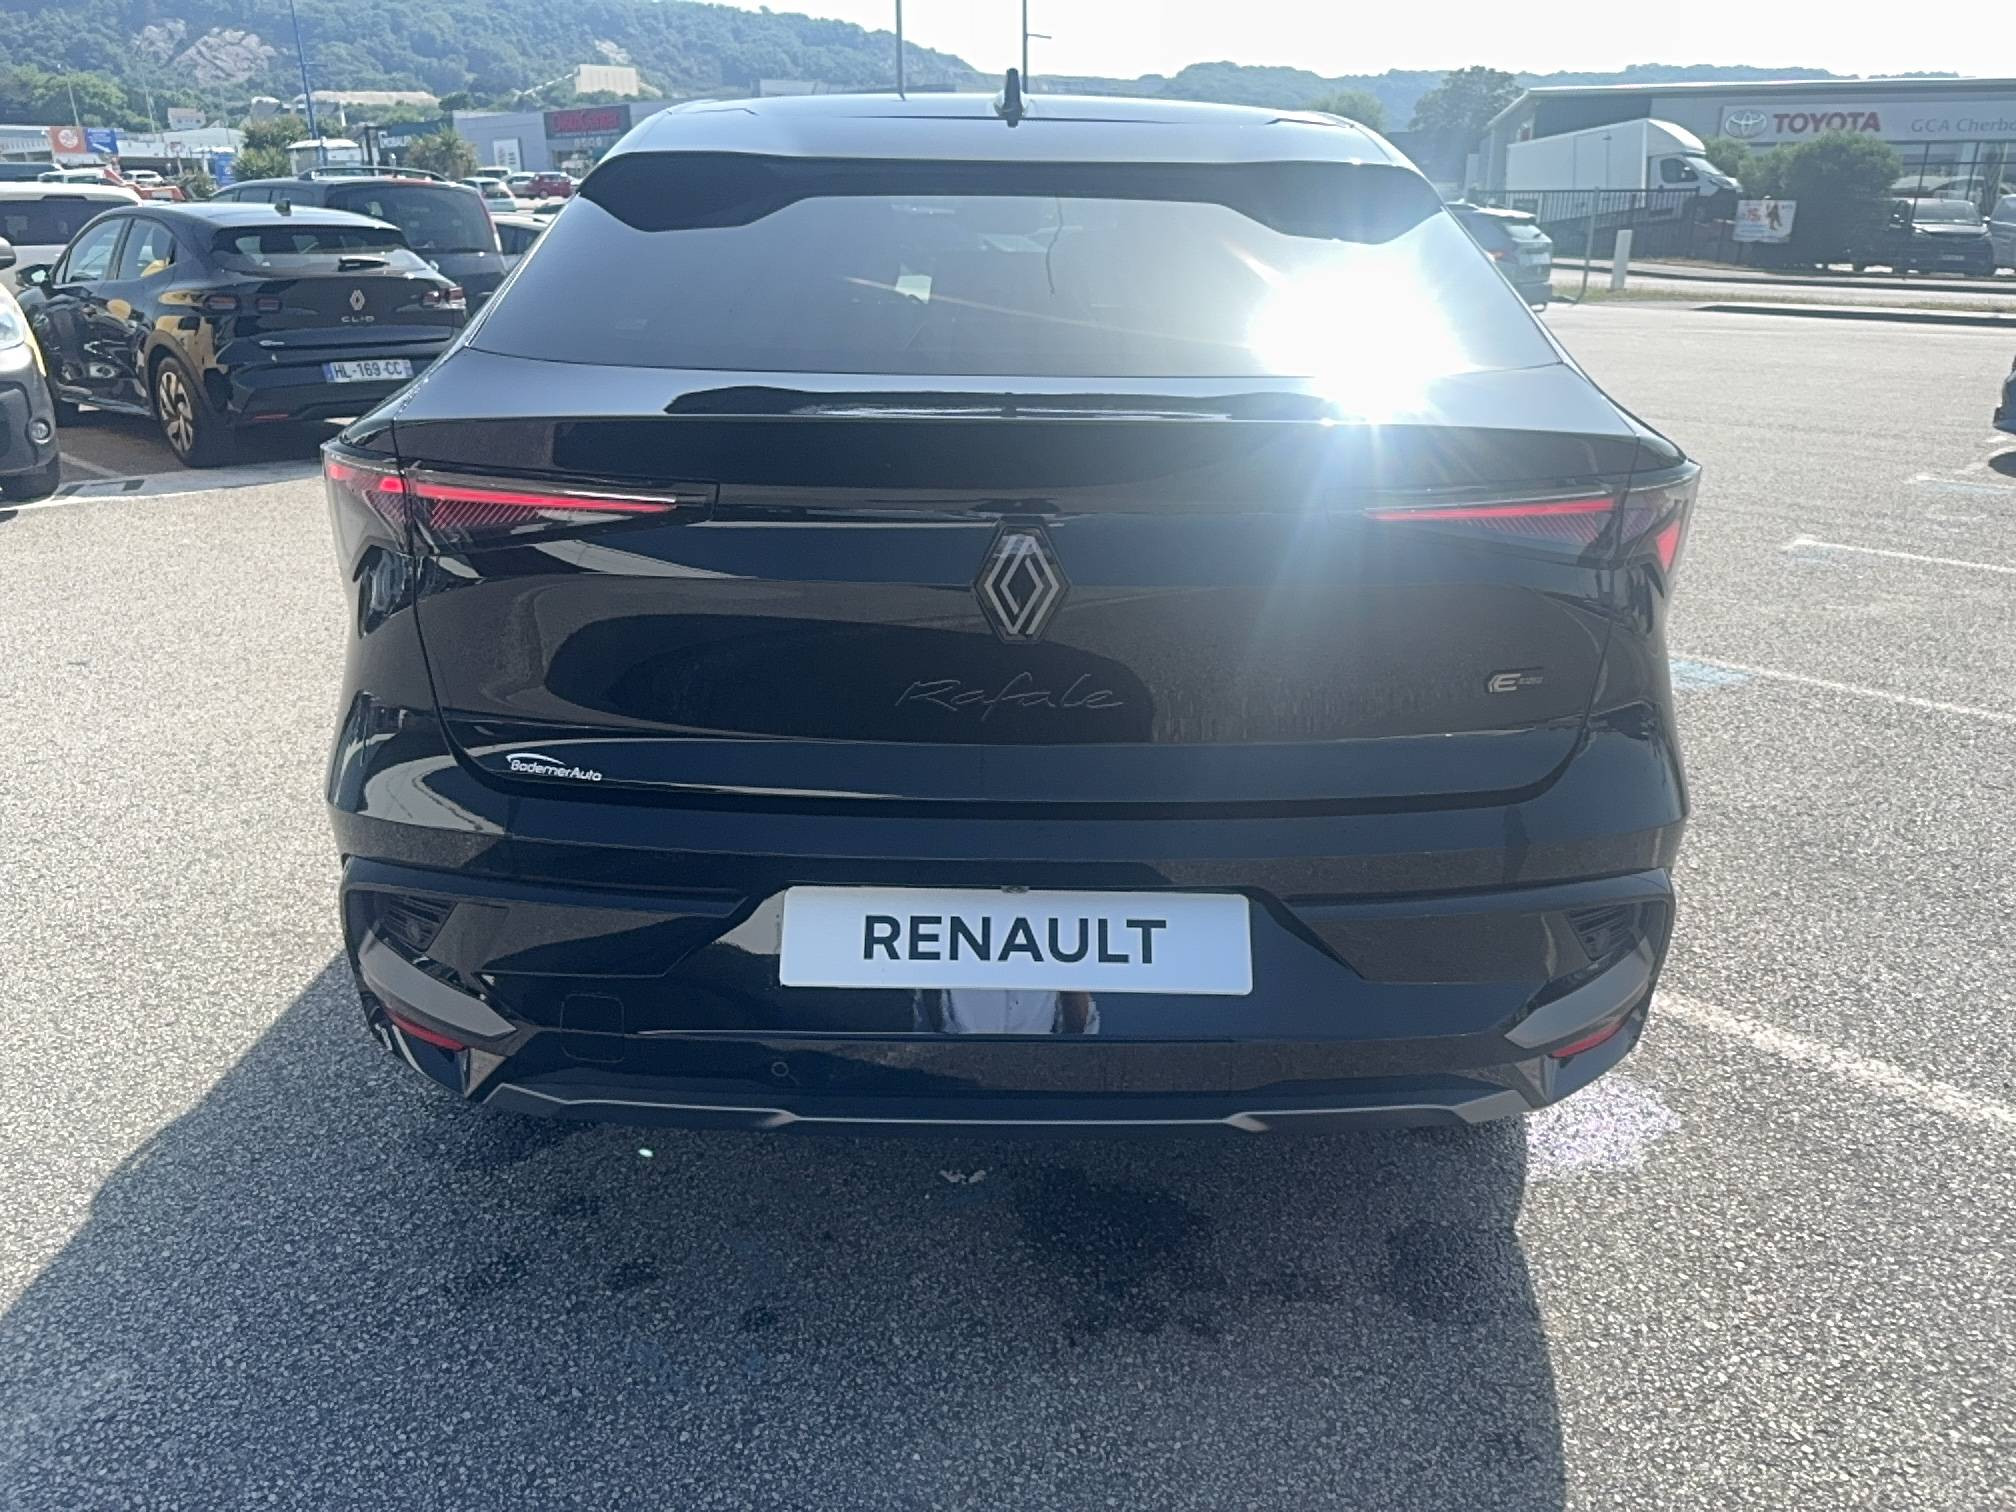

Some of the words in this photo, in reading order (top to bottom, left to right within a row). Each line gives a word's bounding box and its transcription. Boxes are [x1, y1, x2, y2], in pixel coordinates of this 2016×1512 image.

[1773, 111, 1881, 133] TOYOTA
[1911, 118, 1950, 133] GCA
[896, 672, 1124, 721] Rafale
[510, 760, 603, 781] BodemerAuto
[863, 915, 1167, 964] RENAULT
